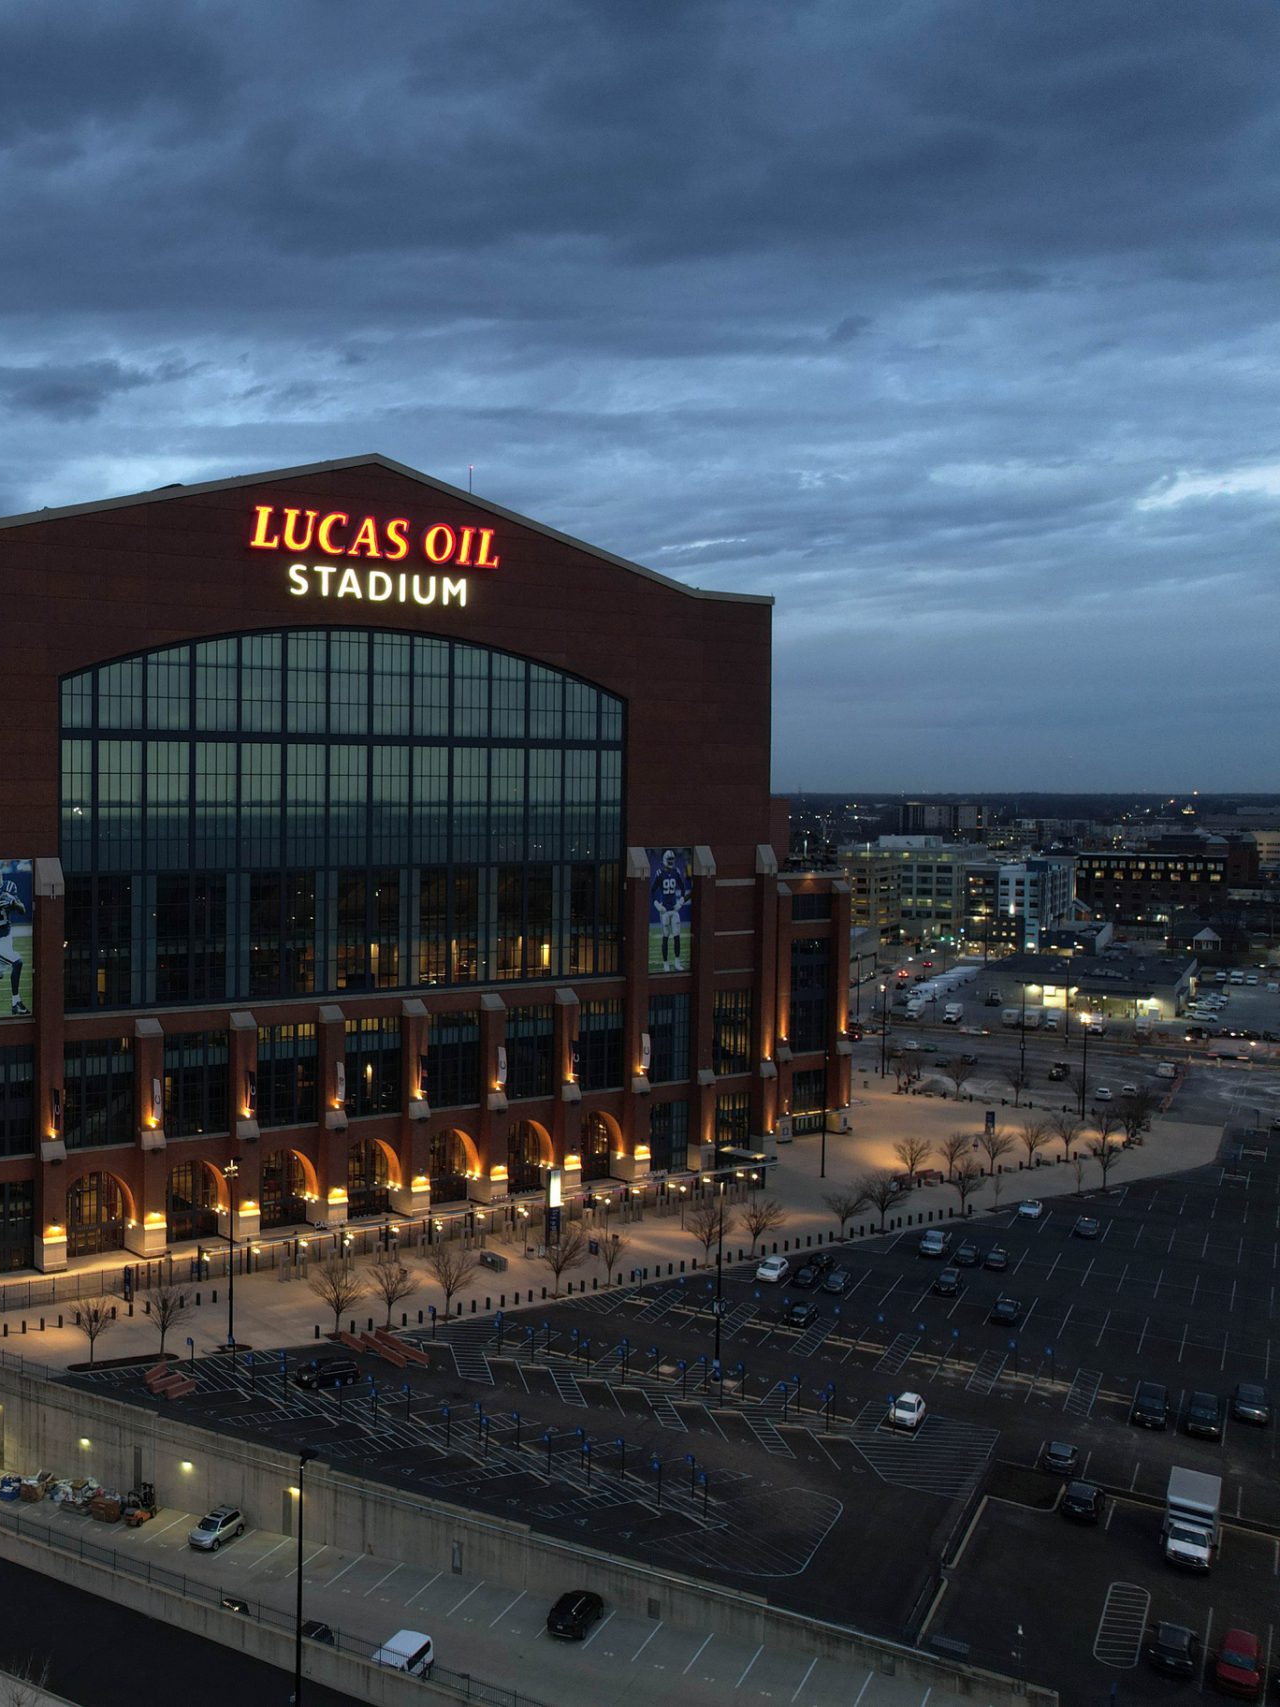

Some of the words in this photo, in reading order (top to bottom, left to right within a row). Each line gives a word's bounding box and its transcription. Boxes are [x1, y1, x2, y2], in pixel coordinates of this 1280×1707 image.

[250, 505, 410, 560] LUCAS
[424, 523, 500, 569] OIL
[288, 563, 467, 607] STADIUM
[663, 879, 676, 894] 99
